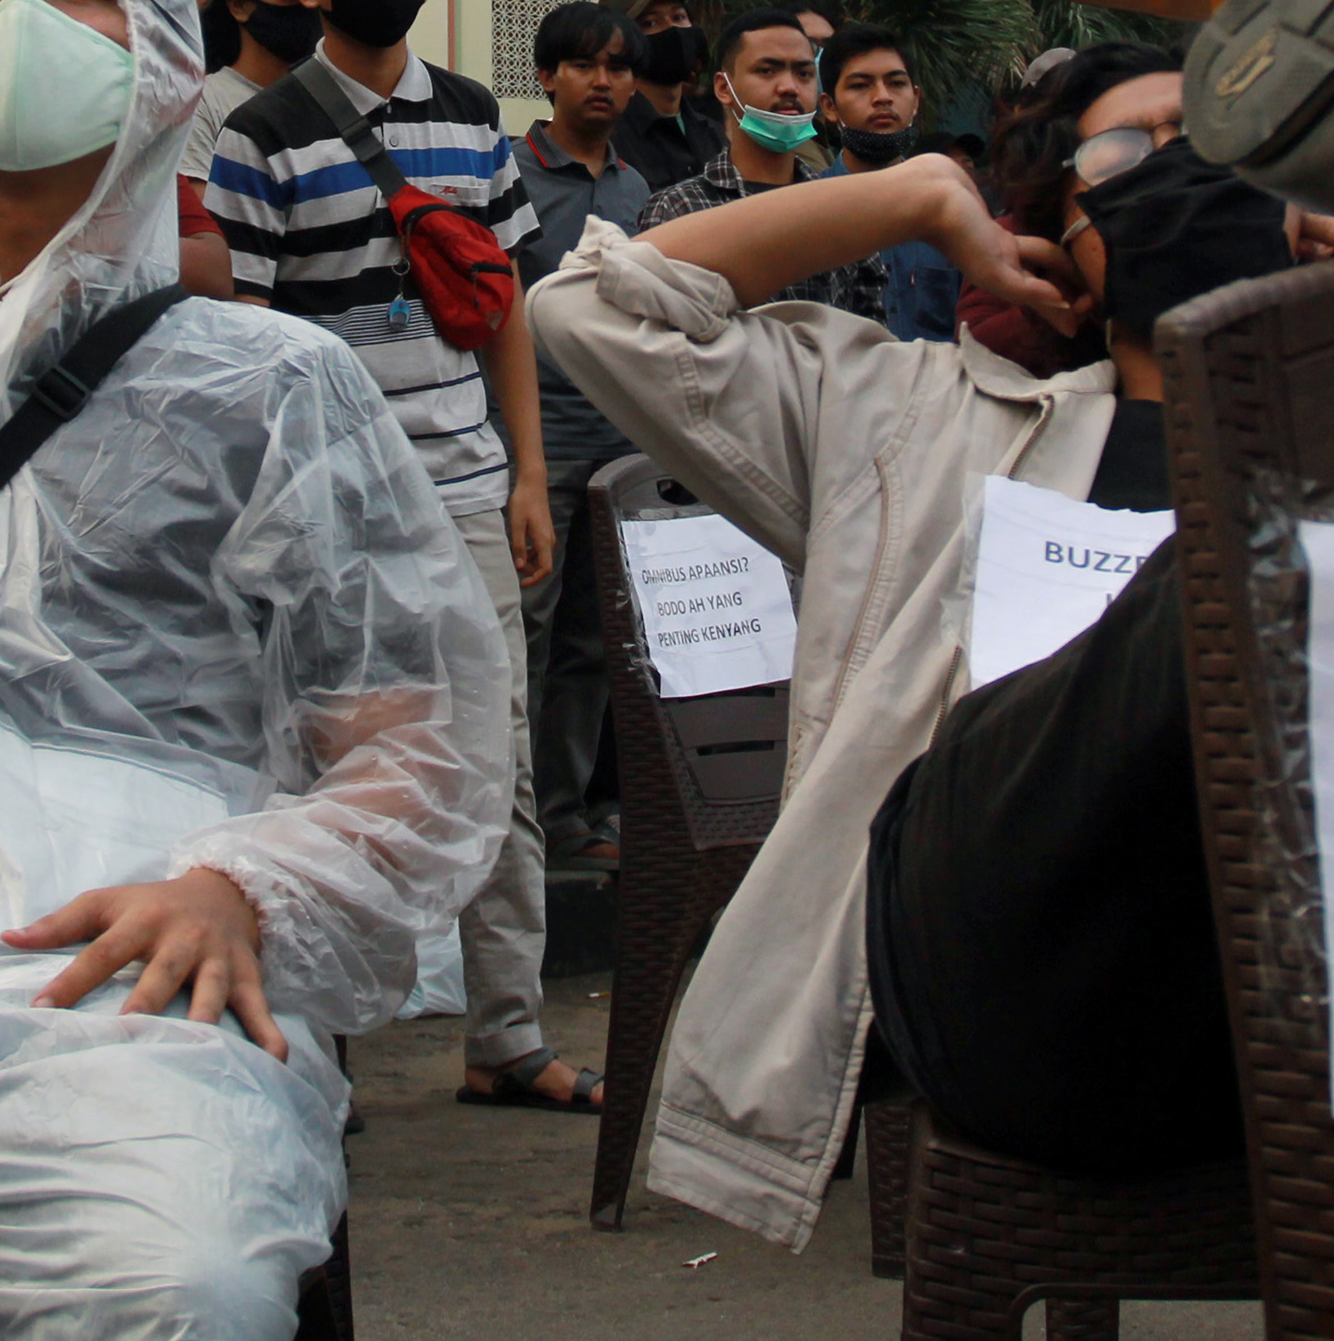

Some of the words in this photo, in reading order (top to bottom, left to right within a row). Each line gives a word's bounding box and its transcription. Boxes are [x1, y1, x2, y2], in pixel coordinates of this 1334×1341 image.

[641, 566, 687, 585] OMNIBUS
[688, 556, 749, 581] APAANSI?
[657, 599, 687, 617] BODO
[689, 597, 706, 614] AH
[707, 591, 743, 611] YANG
[657, 627, 700, 647] PENTING
[700, 618, 762, 642] KENYANG
